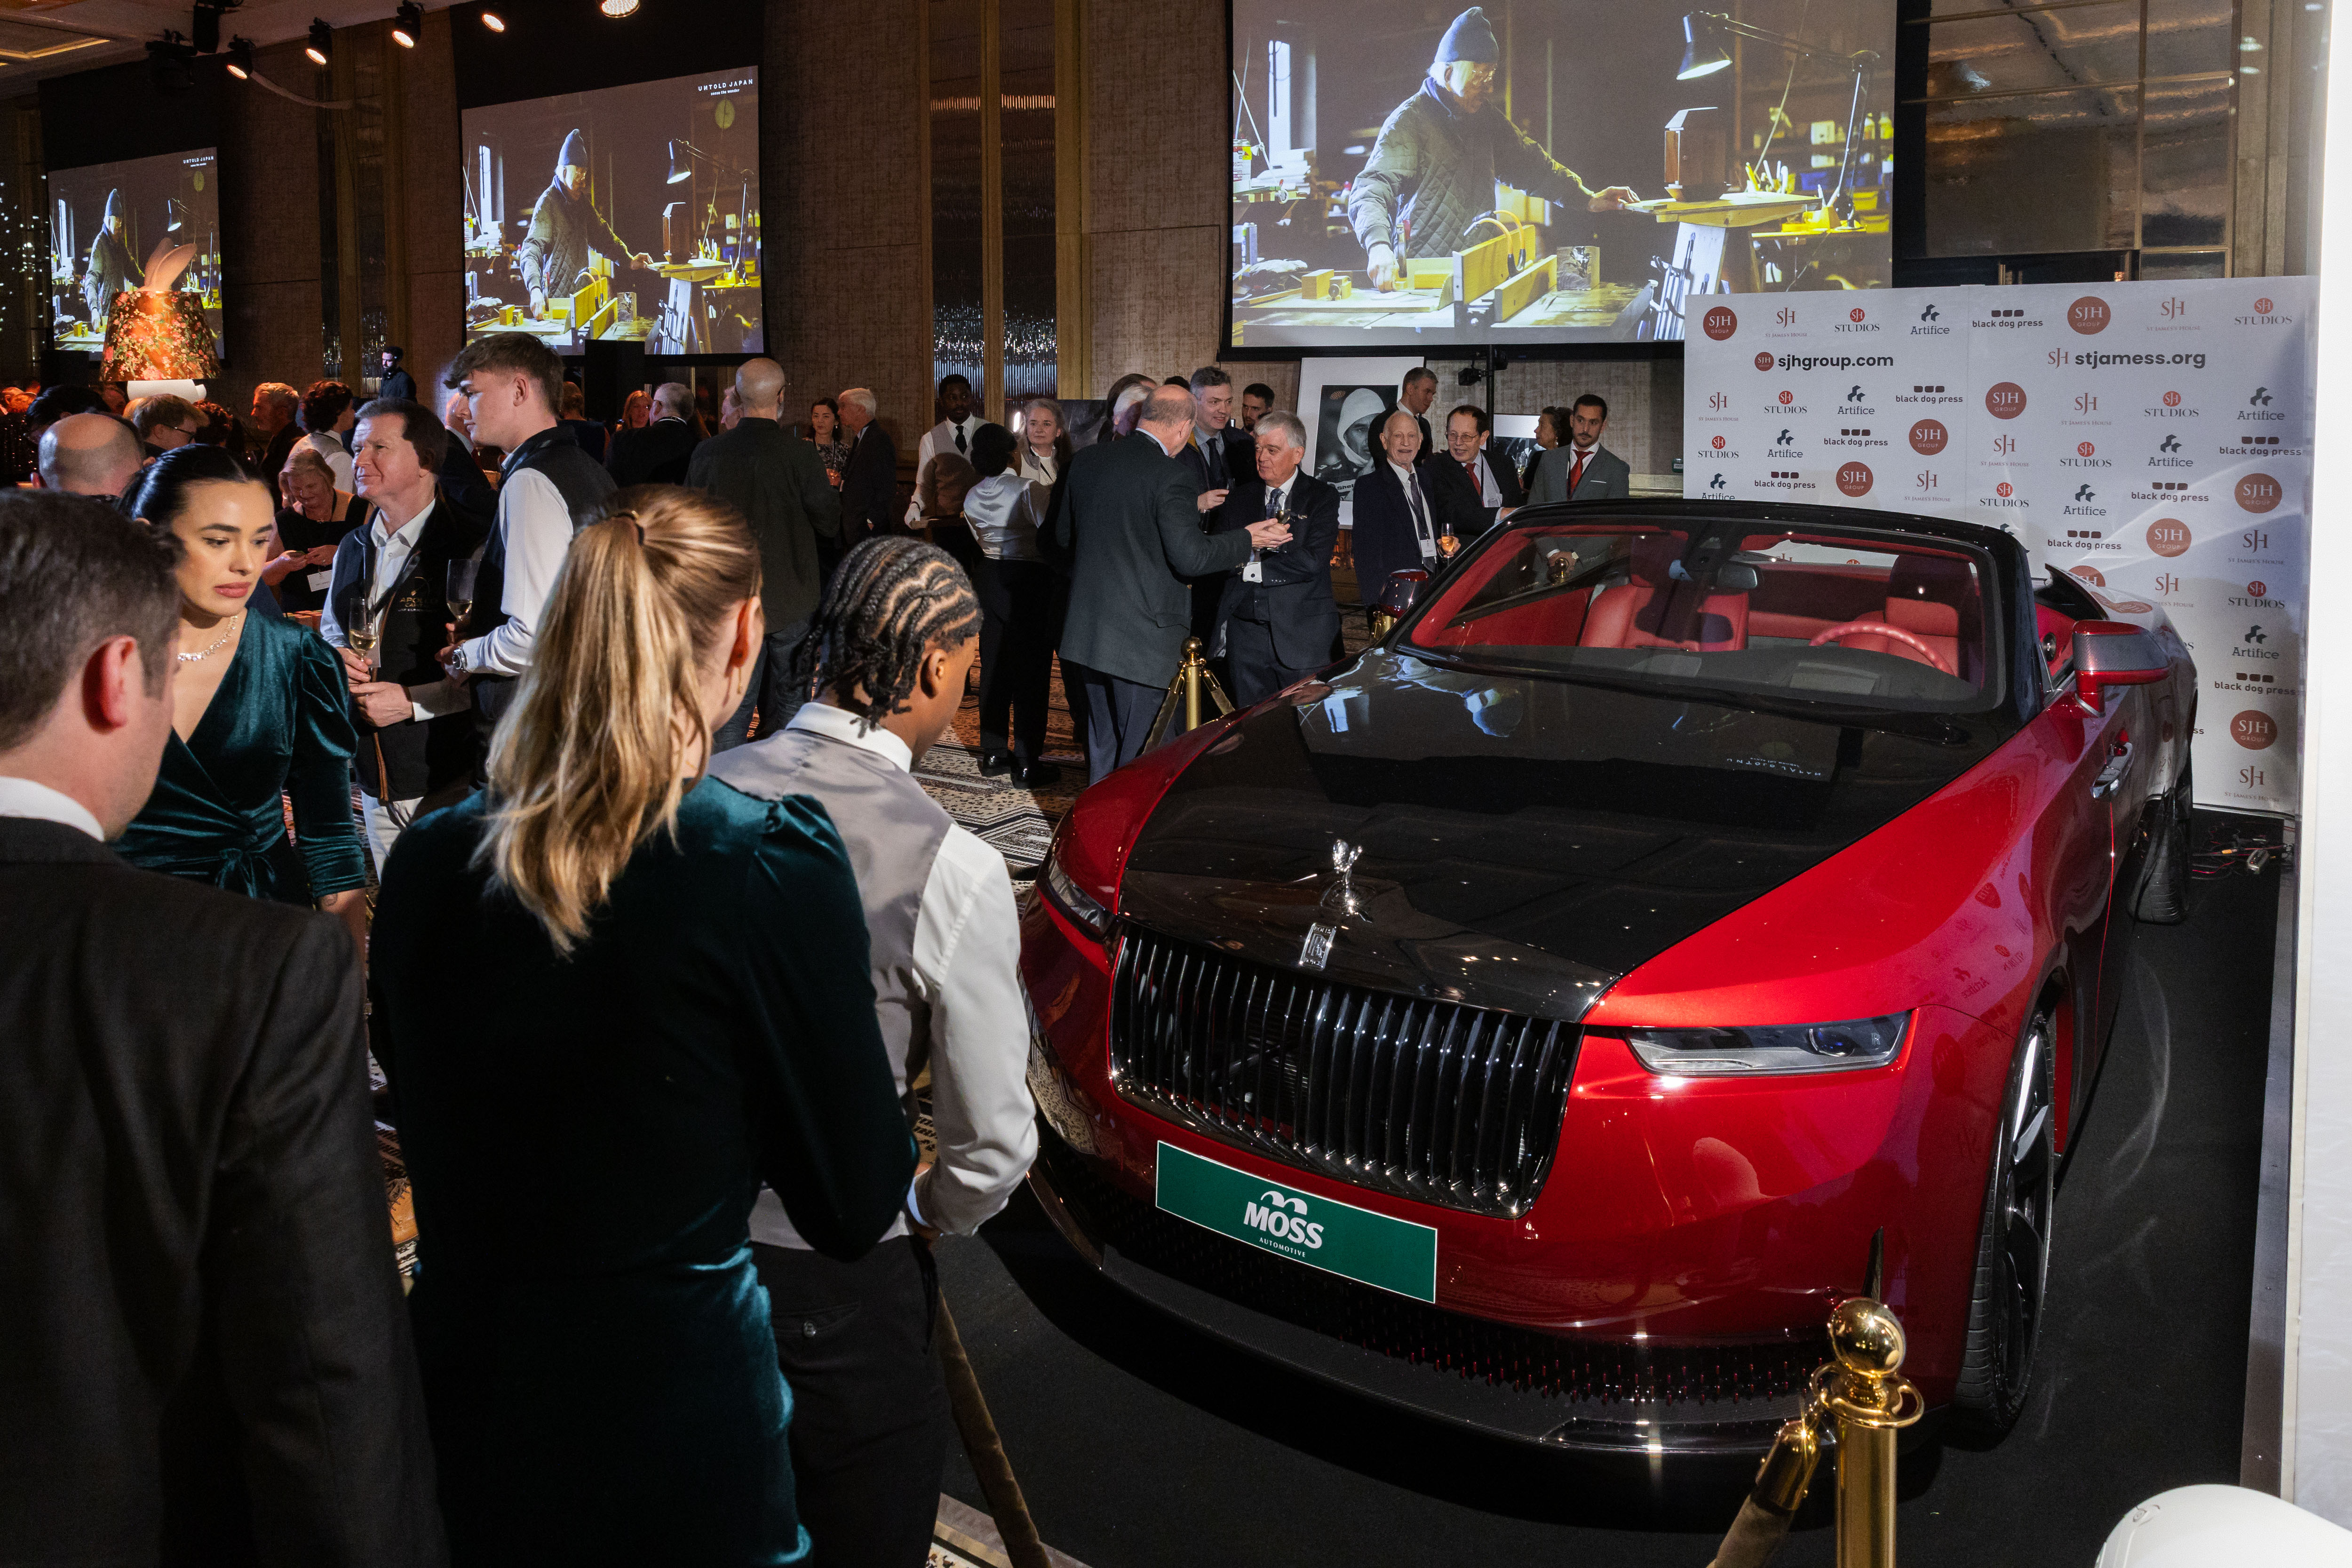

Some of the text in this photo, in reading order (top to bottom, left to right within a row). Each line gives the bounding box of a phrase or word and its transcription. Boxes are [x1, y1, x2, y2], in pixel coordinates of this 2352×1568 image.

[698, 79, 753, 91] UNTOLD JAPAN
[2161, 297, 2185, 320] SJH
[2256, 299, 2272, 313] SJH
[1777, 308, 1795, 328] SJH
[1851, 309, 1864, 322] SJH
[2075, 306, 2103, 321] SJH
[1709, 316, 1731, 327] SJH
[1999, 319, 2015, 329] dog
[2234, 316, 2292, 325] STUDIOS
[1835, 324, 1880, 332] STUDIOS
[1910, 325, 1950, 334] Artifice
[1778, 354, 1893, 371] sjhgroup.com
[2048, 348, 2069, 368] SJH
[2075, 350, 2206, 369] stjamess.org
[1709, 392, 1727, 412] SJH
[1780, 392, 1792, 404] SJH
[1921, 395, 1936, 404] dog
[1993, 391, 2019, 405] SJH
[2074, 393, 2098, 414] SJH
[2164, 393, 2180, 406] SJH
[1764, 405, 1807, 414] STUDIOS
[1837, 406, 1875, 415] Artifice
[2144, 407, 2199, 418] STUDIOS
[2237, 410, 2285, 421] Artifice
[1916, 429, 1940, 441] SJH
[1713, 437, 1724, 448] SJH
[1824, 438, 1845, 446] black
[1848, 438, 1862, 447] dog
[1994, 435, 2016, 457] SJH
[1698, 450, 1739, 459] STUDIOS
[1767, 449, 1803, 458] Artifice
[2079, 443, 2093, 456] SJH
[2219, 446, 2301, 457] black dog press
[2059, 457, 2112, 468] STUDIOS
[2148, 456, 2193, 467] Artifice
[1843, 471, 1867, 483] SJH
[1917, 470, 1938, 492] SJH
[1777, 480, 1791, 489] dog
[1997, 483, 2011, 496] SJH
[2131, 492, 2209, 502] black dog press
[2243, 484, 2273, 498] SJH
[1979, 498, 2029, 508] STUDIOS
[2063, 506, 2106, 516] Artifice
[2154, 528, 2183, 541] SJH
[2047, 539, 2122, 550] black dog press
[2243, 530, 2268, 553] SJH
[2155, 573, 2179, 596] SJH
[2249, 581, 2265, 597] SJH
[2228, 597, 2285, 609] STUDIOS
[2232, 647, 2279, 659] Artifice
[2214, 681, 2296, 695] black dog press
[2239, 720, 2269, 733] SJH
[2240, 766, 2265, 789] SJH
[1243, 1201, 1324, 1249] MOSS
[1259, 1237, 1306, 1258] AUTOMOTIVE
